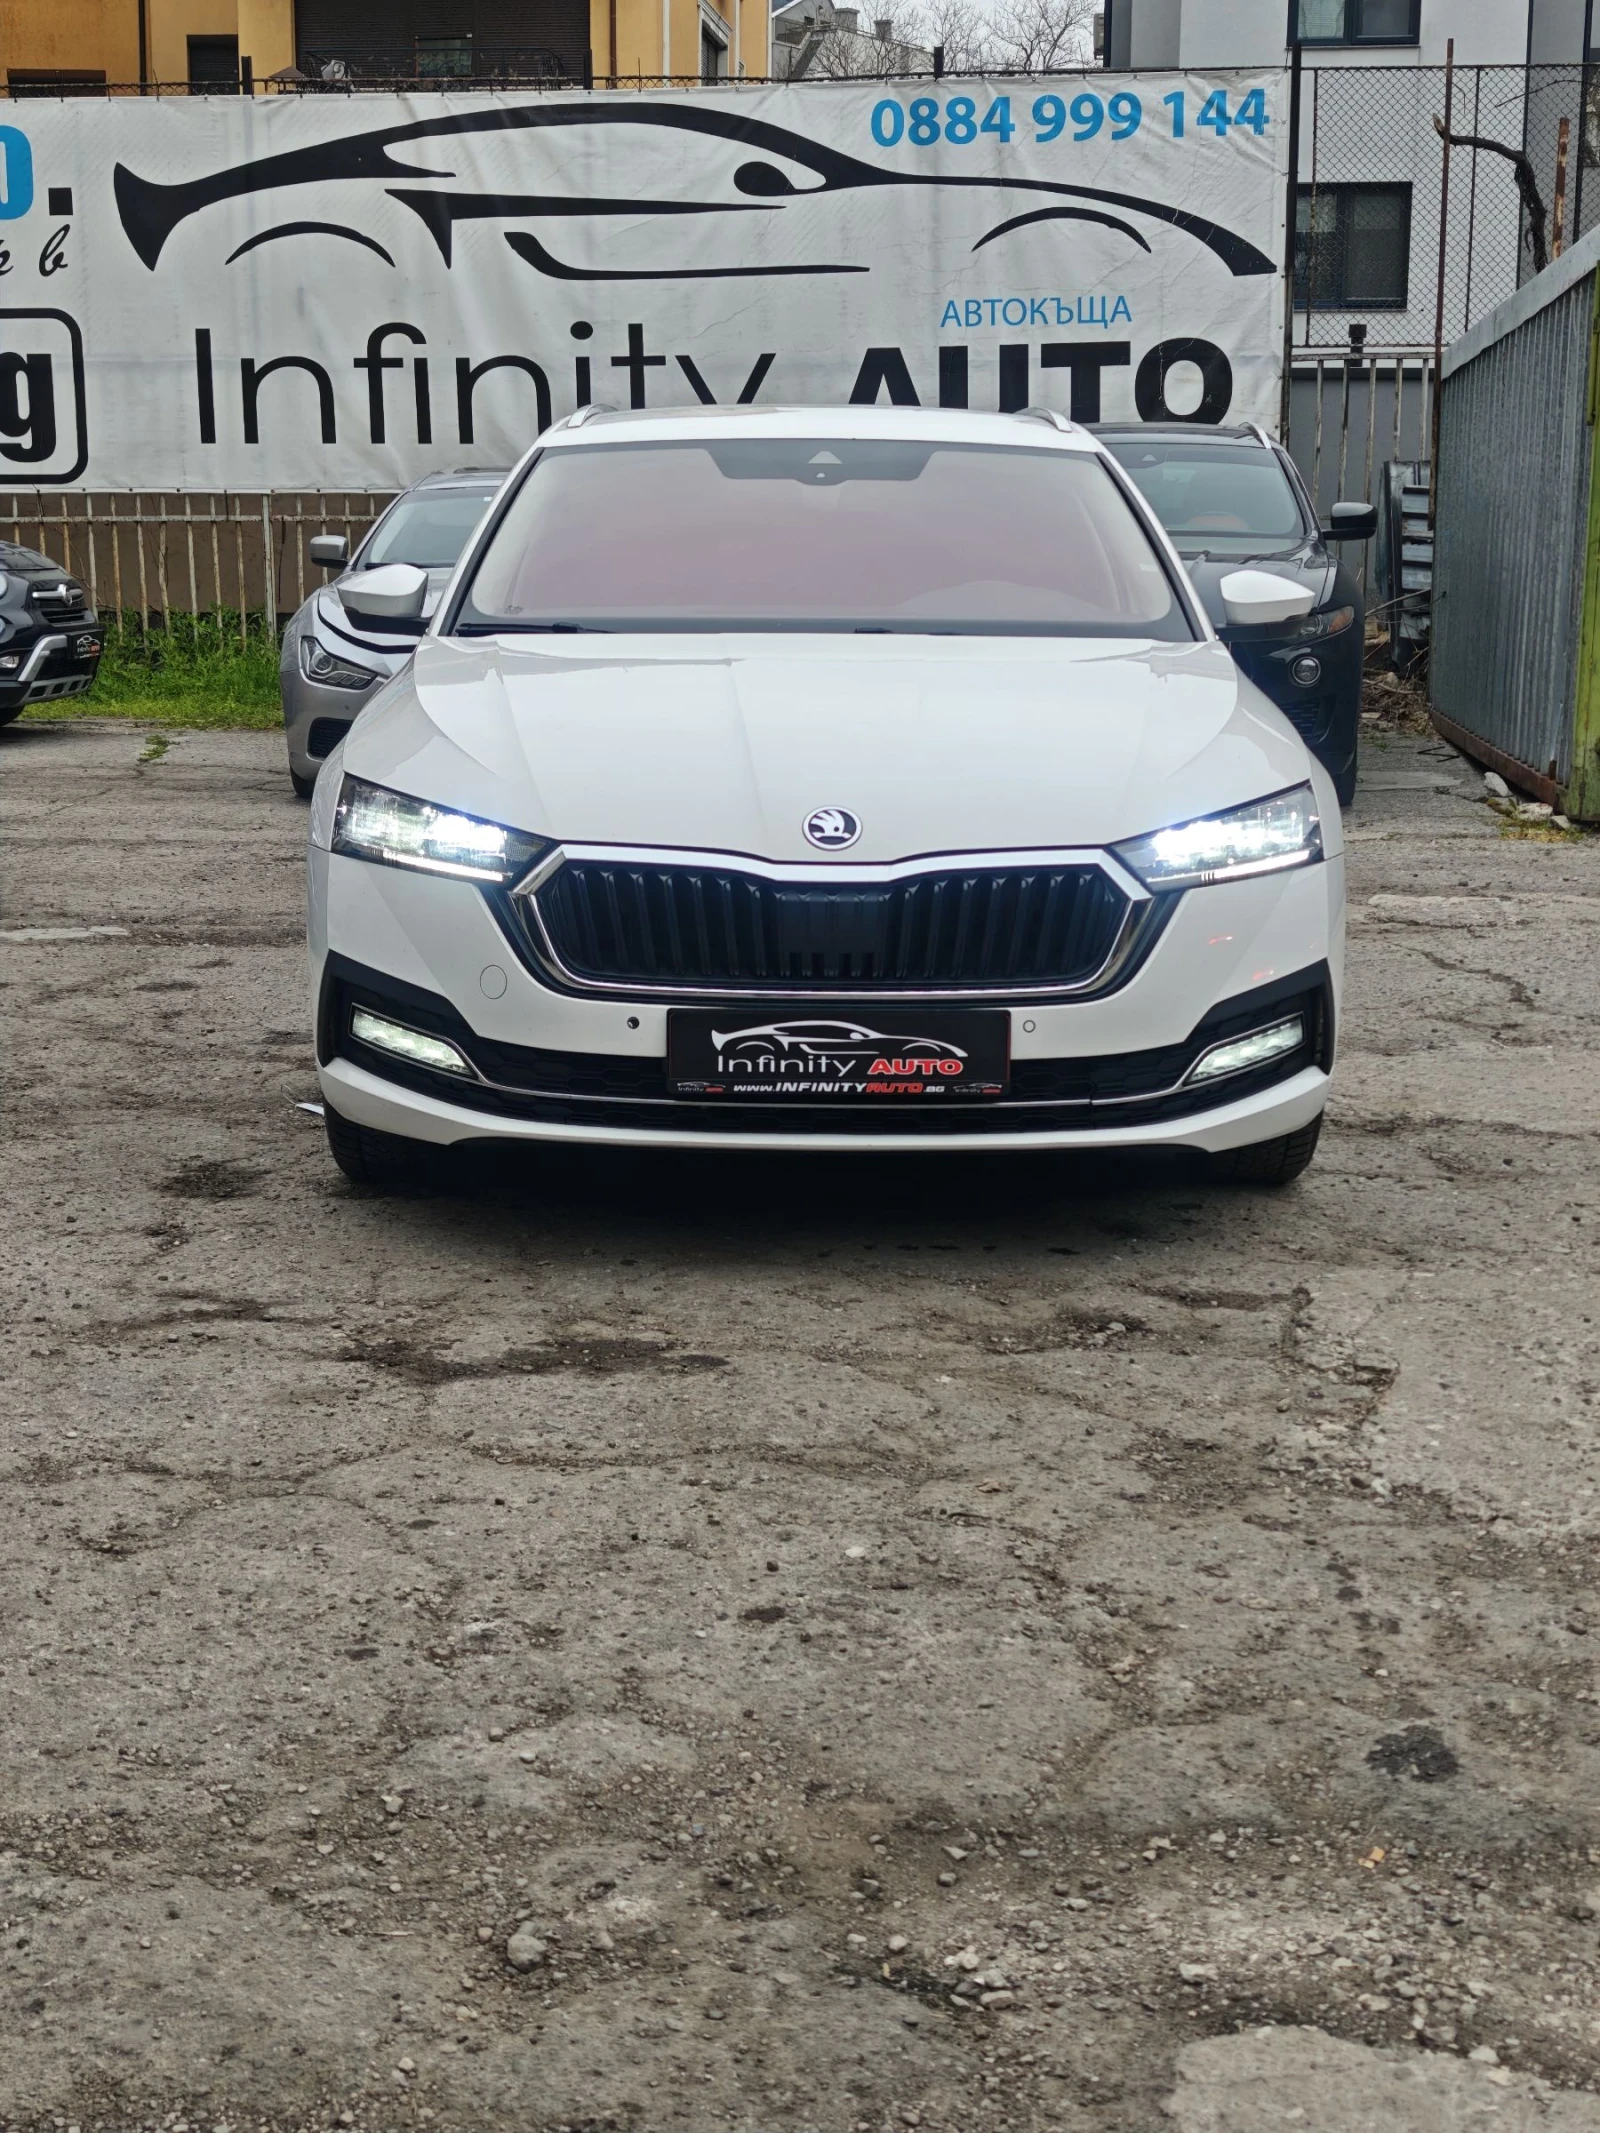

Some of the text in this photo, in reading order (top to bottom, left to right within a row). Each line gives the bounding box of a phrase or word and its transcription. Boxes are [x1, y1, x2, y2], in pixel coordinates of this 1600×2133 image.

[870, 88, 1270, 147] 0884 999 144
[940, 295, 1132, 329] АВТОКЪЩА
[848, 337, 1233, 425] AUTO
[717, 1055, 964, 1077] Infinity AUTO
